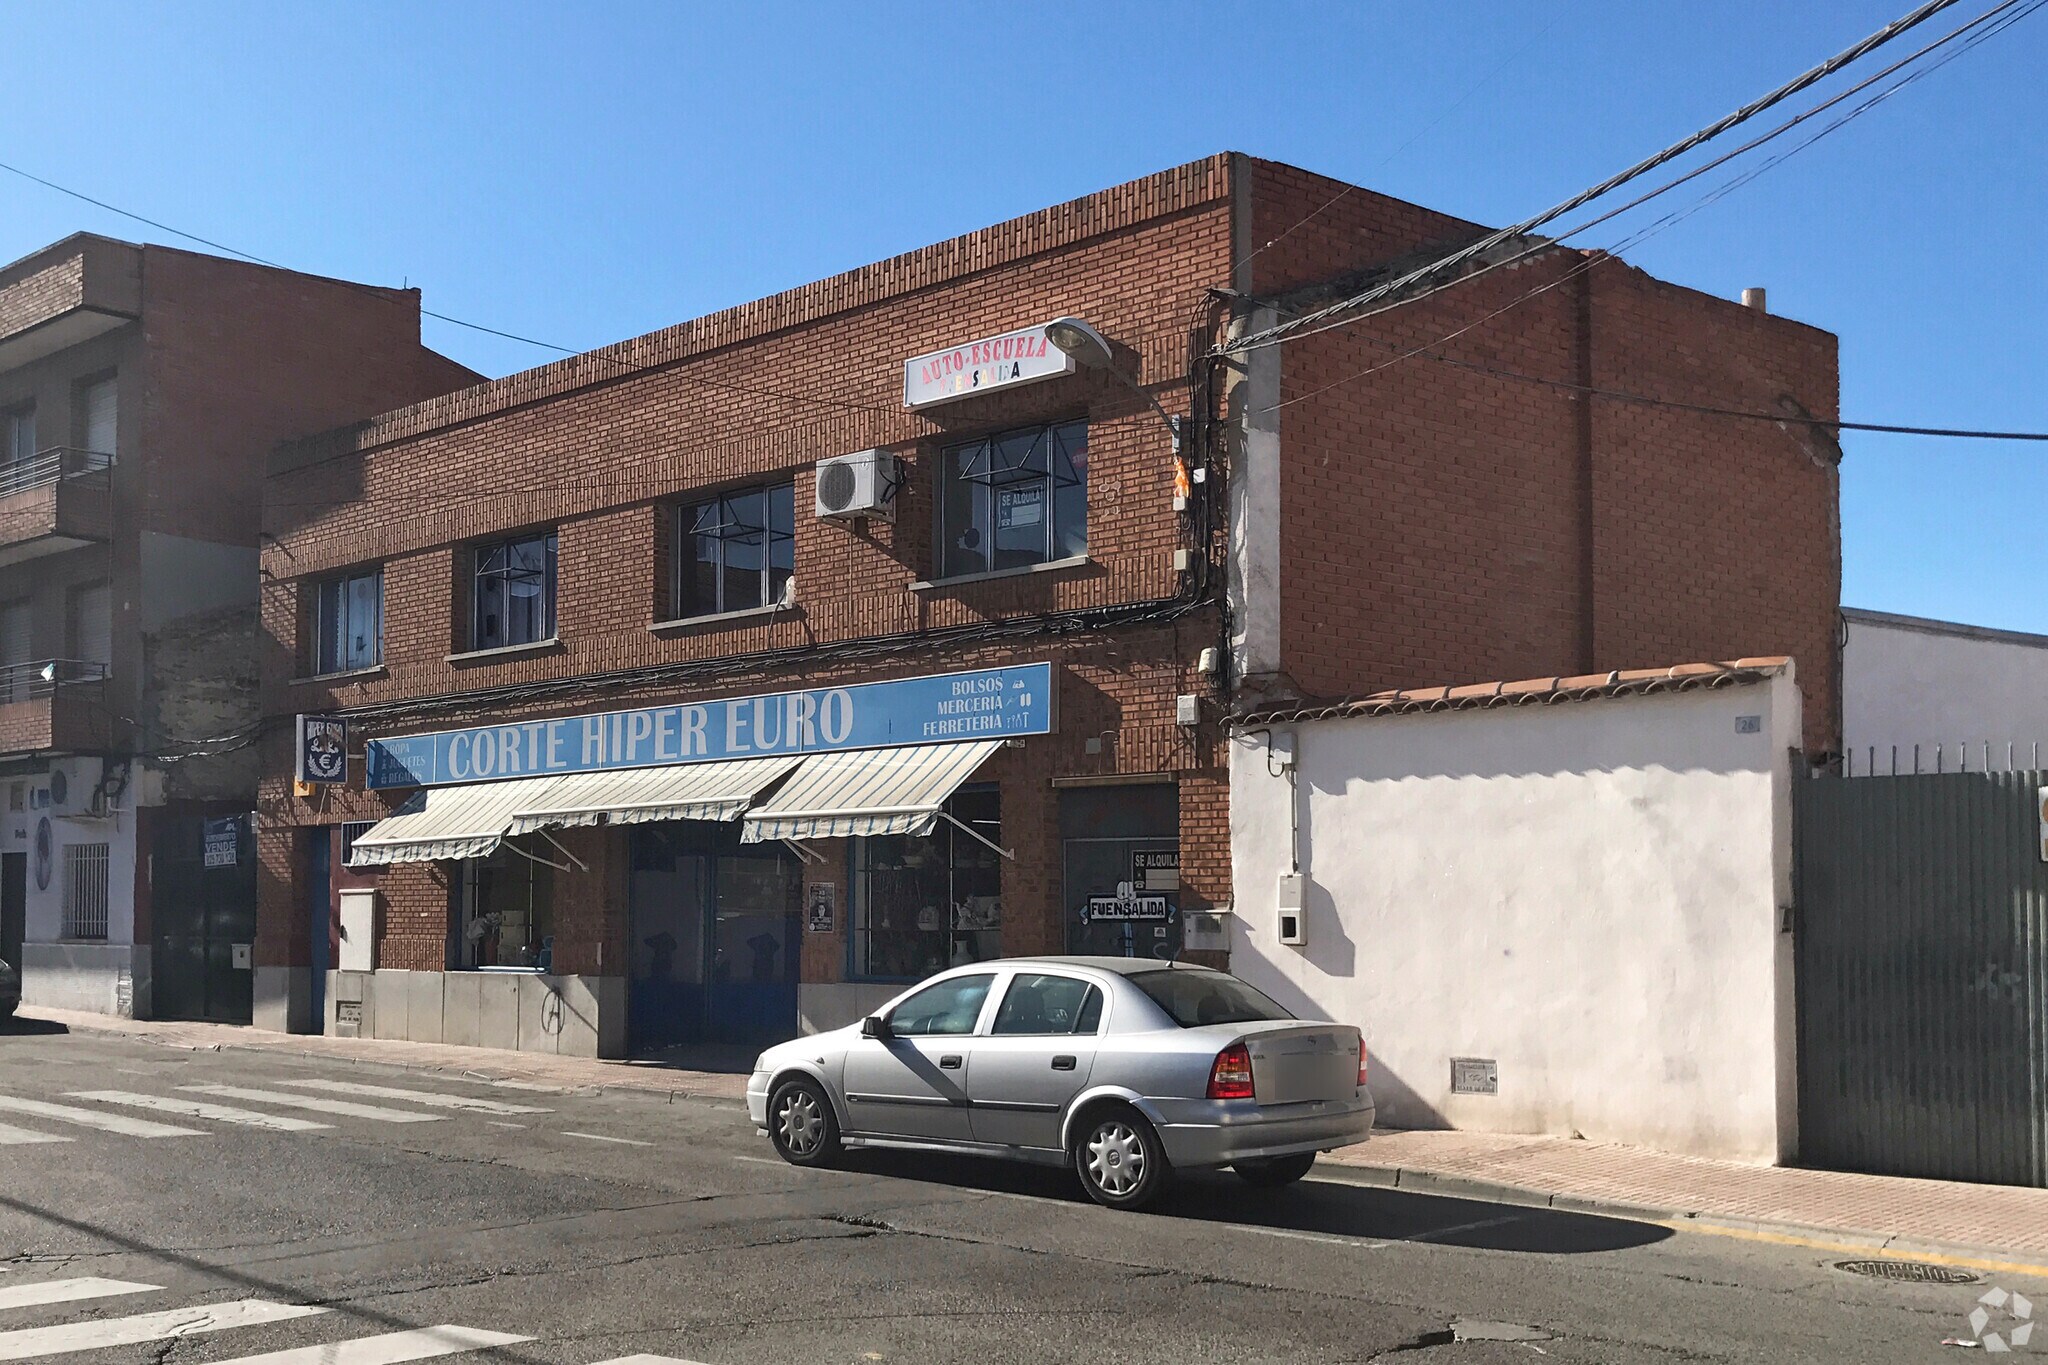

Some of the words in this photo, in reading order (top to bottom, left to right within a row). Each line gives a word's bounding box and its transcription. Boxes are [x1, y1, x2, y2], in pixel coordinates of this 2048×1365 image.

[922, 336, 1047, 384] AUTO-ESCUELA
[1002, 495, 1011, 506] SE
[1012, 490, 1040, 505] ALQUILA
[952, 677, 1003, 696] BOLSOS
[938, 695, 1003, 715] MERCERIA
[923, 714, 1002, 736] FERRETERIA
[1741, 719, 1755, 731] 26
[449, 720, 567, 779] CORTE
[582, 705, 708, 764] HIPER
[726, 689, 853, 752] EURO
[389, 743, 410, 755] ROPA
[388, 770, 422, 784] REGALOS
[205, 840, 236, 853] VENDE
[1135, 854, 1145, 867] SE
[1146, 853, 1178, 867] ALQUILA
[1091, 901, 1165, 916] FUENSALIDA
